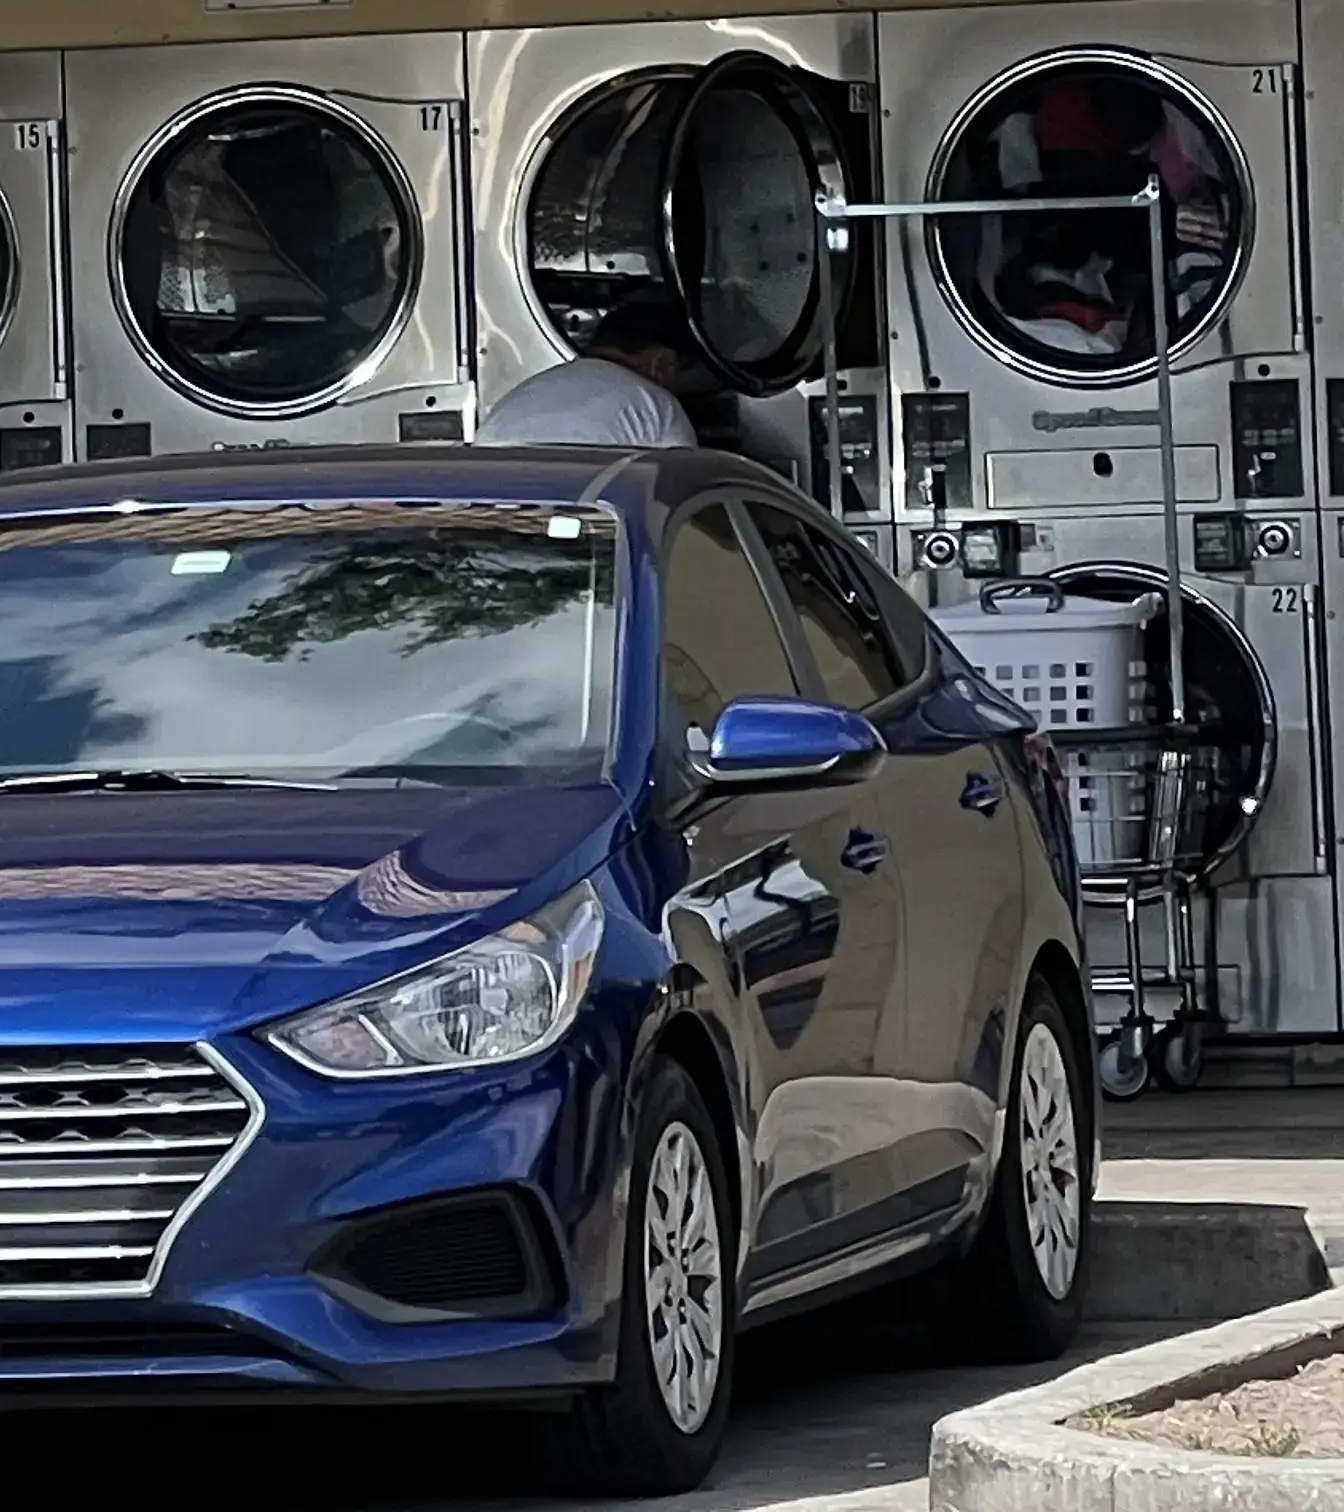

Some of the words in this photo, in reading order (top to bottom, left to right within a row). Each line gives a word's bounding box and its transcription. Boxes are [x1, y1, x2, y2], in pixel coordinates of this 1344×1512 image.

[1253, 69, 1278, 93] 21
[418, 106, 442, 131] 17
[14, 124, 41, 149] 15
[1272, 587, 1297, 613] 22
